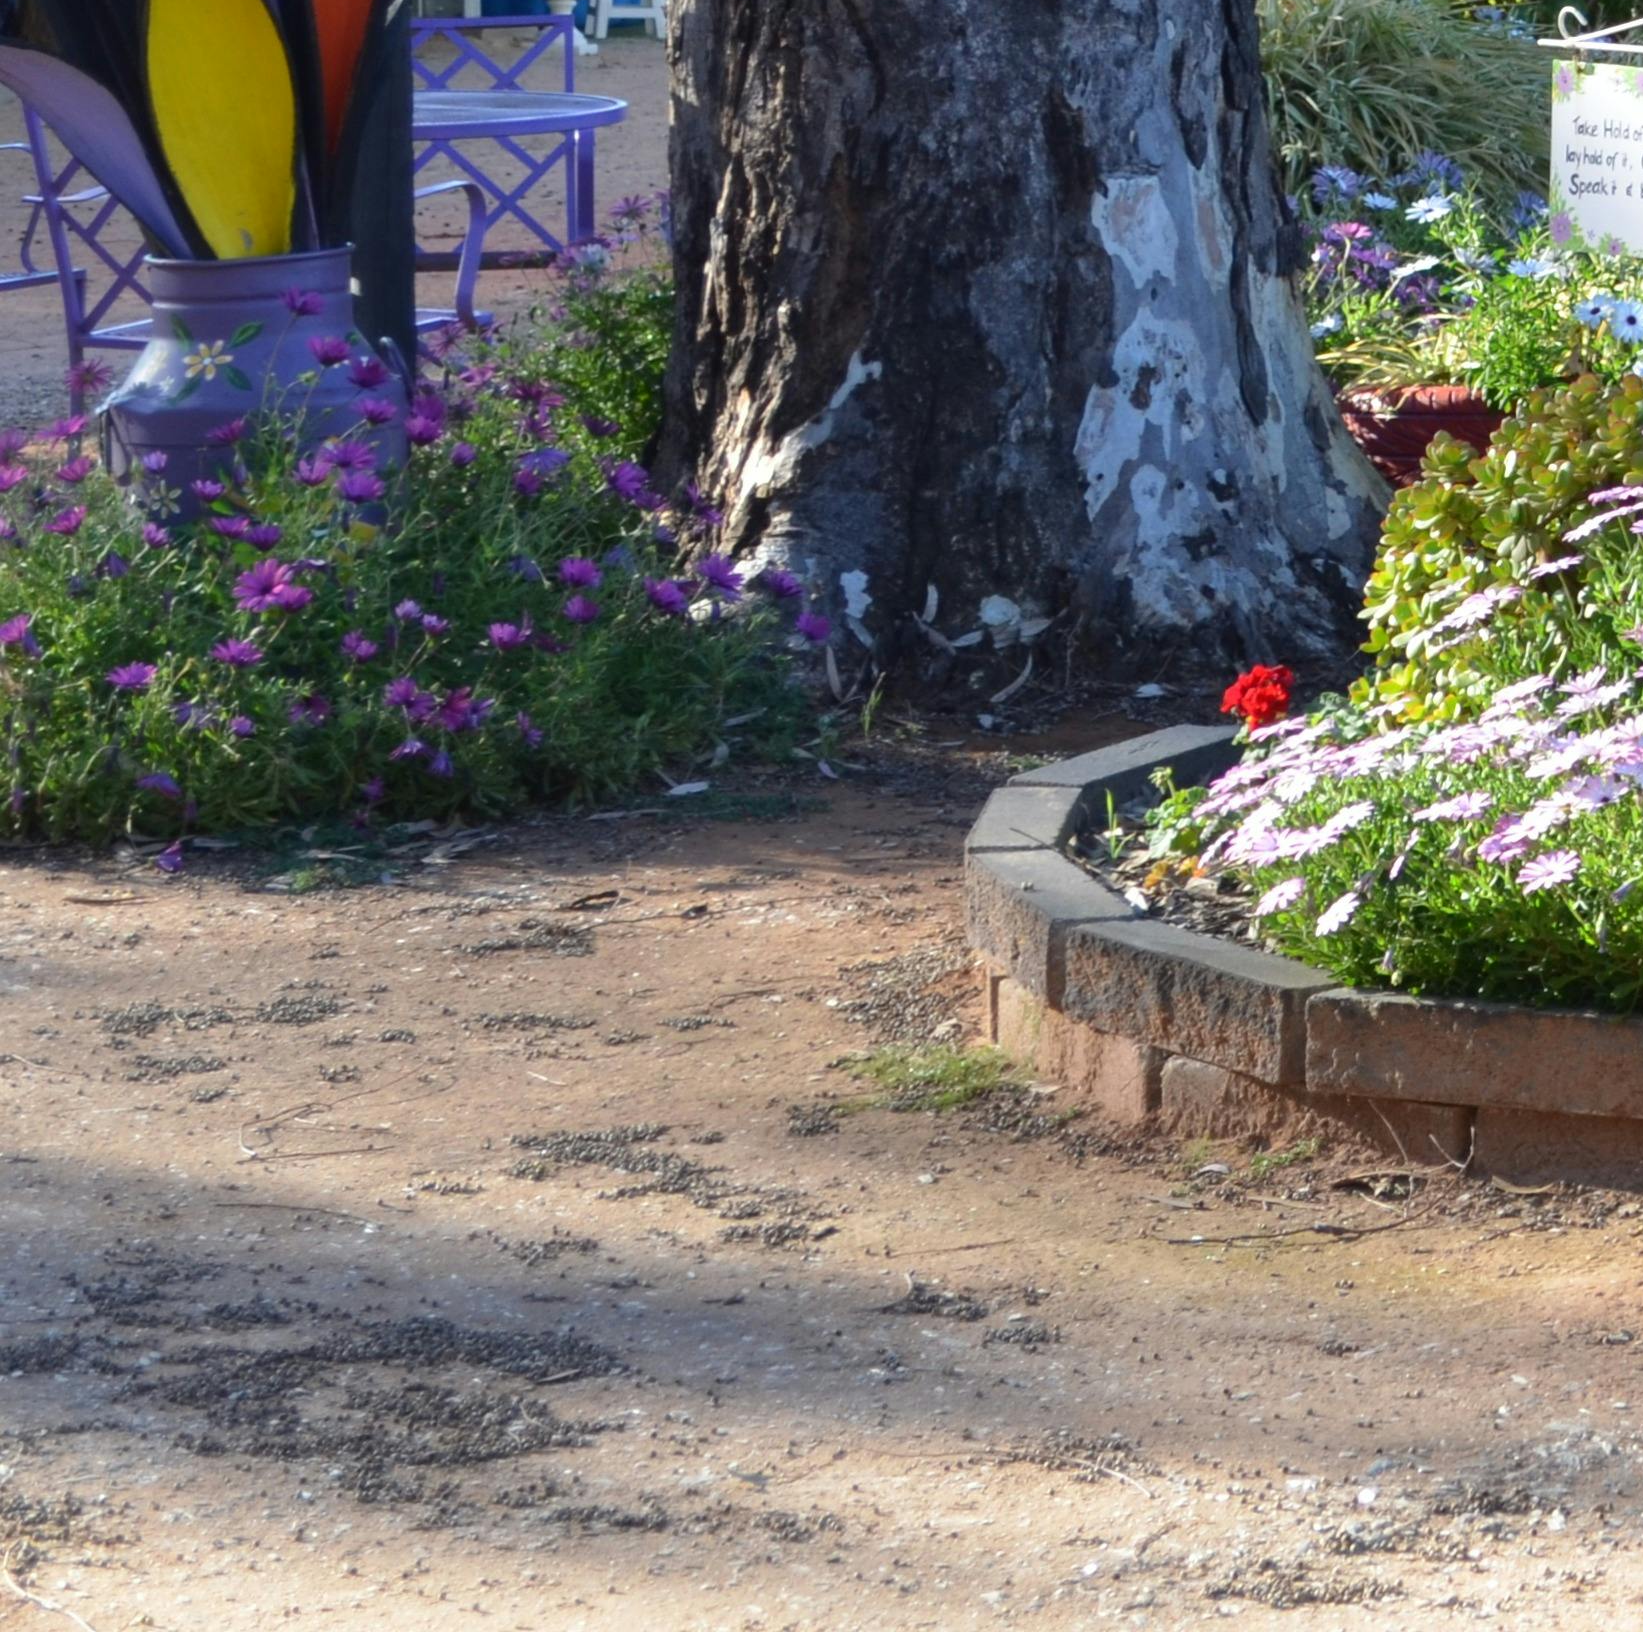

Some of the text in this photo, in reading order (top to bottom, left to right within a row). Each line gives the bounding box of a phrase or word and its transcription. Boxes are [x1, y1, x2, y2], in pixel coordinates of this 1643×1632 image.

[1573, 116, 1598, 137] Take
[1603, 118, 1630, 140] Hold
[1566, 144, 1581, 169] lay
[1583, 146, 1603, 165] hold
[1606, 151, 1619, 171] of
[1568, 173, 1608, 200] Speak
